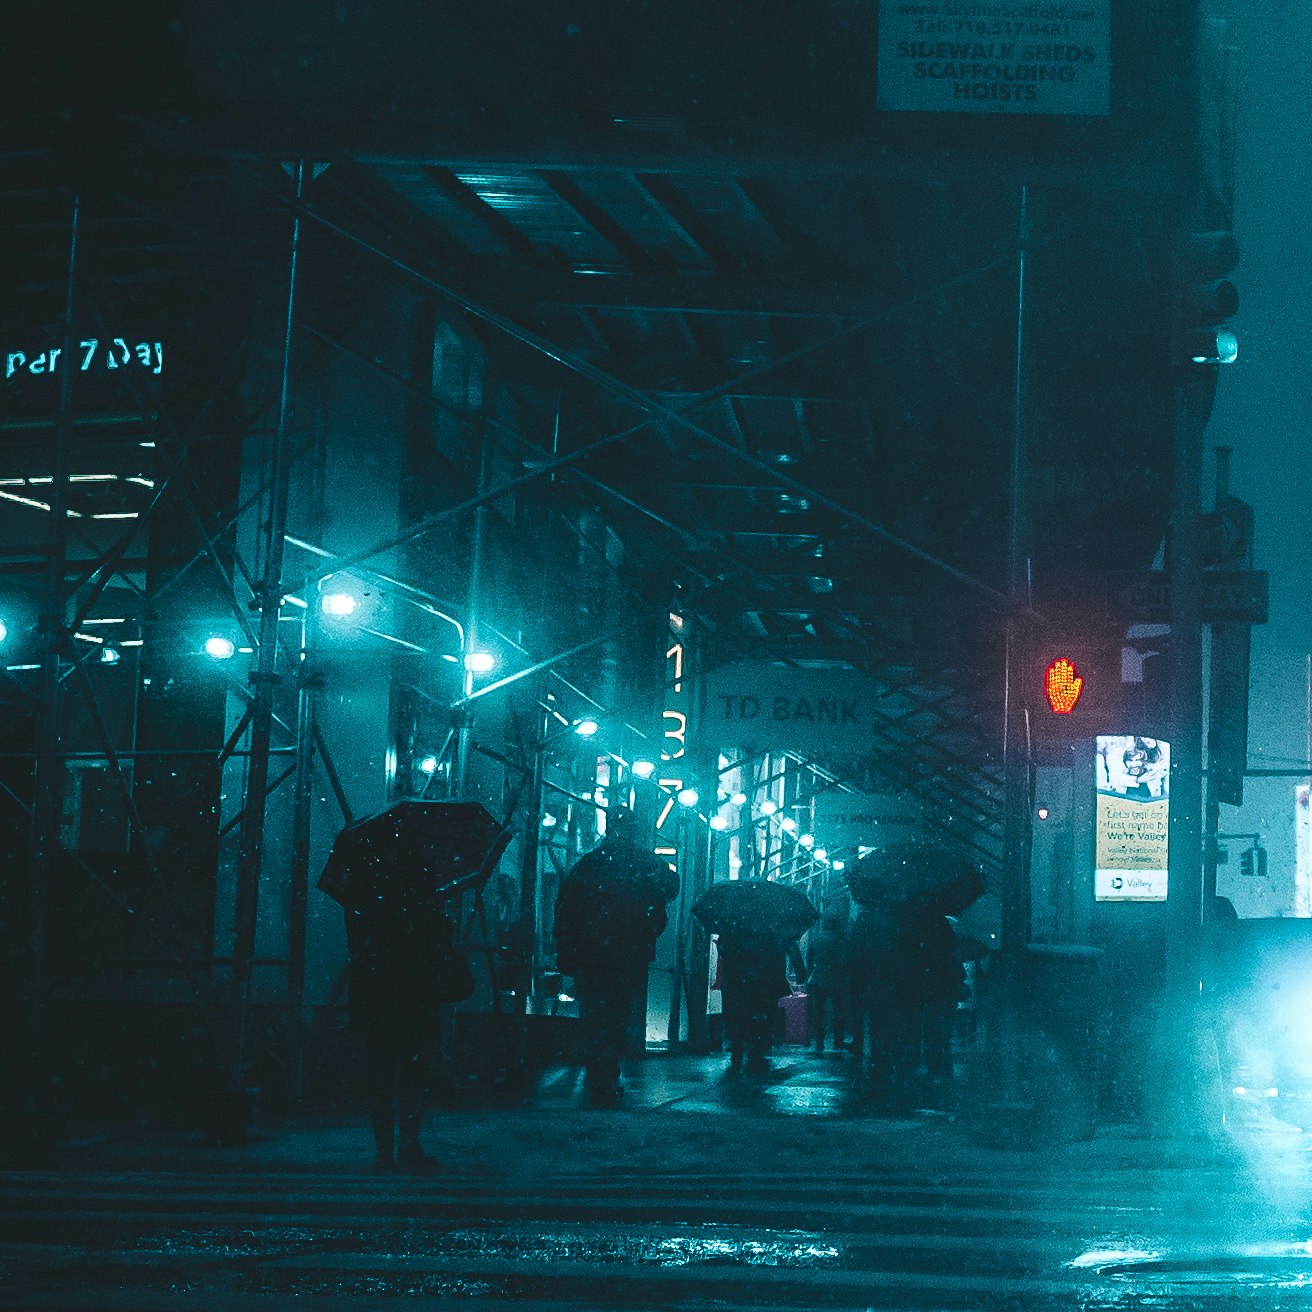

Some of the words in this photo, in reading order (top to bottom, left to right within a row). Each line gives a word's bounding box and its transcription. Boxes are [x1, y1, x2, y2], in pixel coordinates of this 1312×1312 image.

[897, 41, 1015, 60] SIDEWALK
[1022, 43, 1096, 63] SHEDS
[914, 62, 1076, 82] SCAFFOLDING
[953, 83, 1038, 101] HOISTS
[79, 337, 99, 371] 7
[718, 695, 760, 720] TD
[772, 696, 861, 724] BANK
[1126, 878, 1152, 892] Valley
